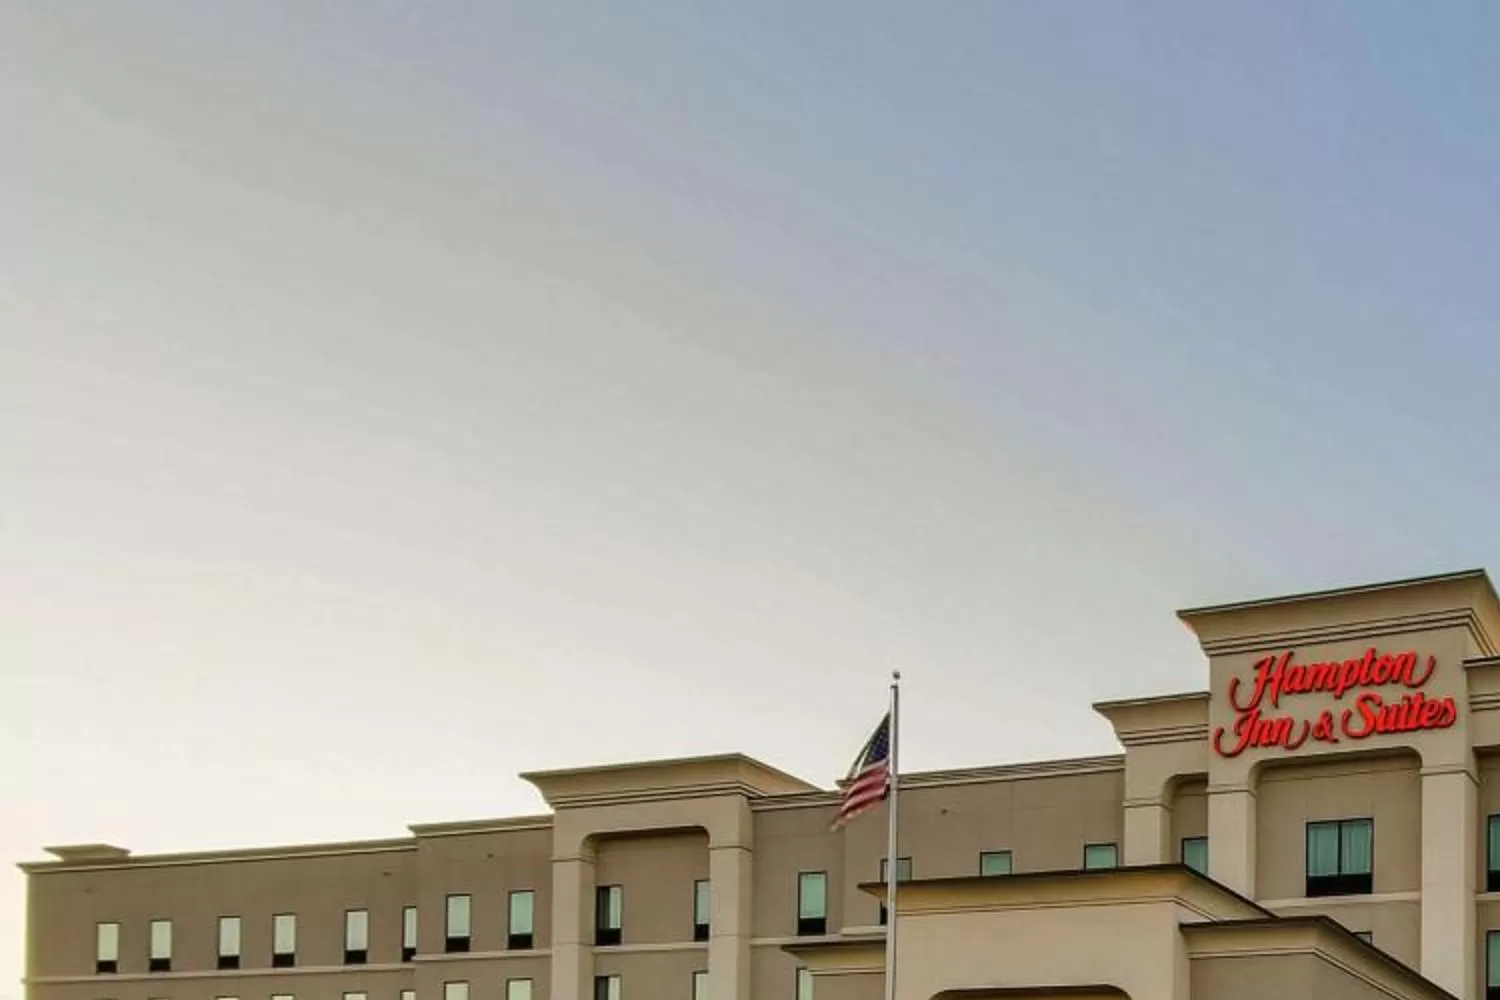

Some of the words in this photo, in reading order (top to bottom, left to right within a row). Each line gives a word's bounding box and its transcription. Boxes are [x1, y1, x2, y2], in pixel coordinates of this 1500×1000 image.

[1229, 647, 1436, 711] Hampton
[1213, 708, 1310, 758] Inn
[1311, 710, 1339, 743] &
[1341, 690, 1457, 739] Suites
